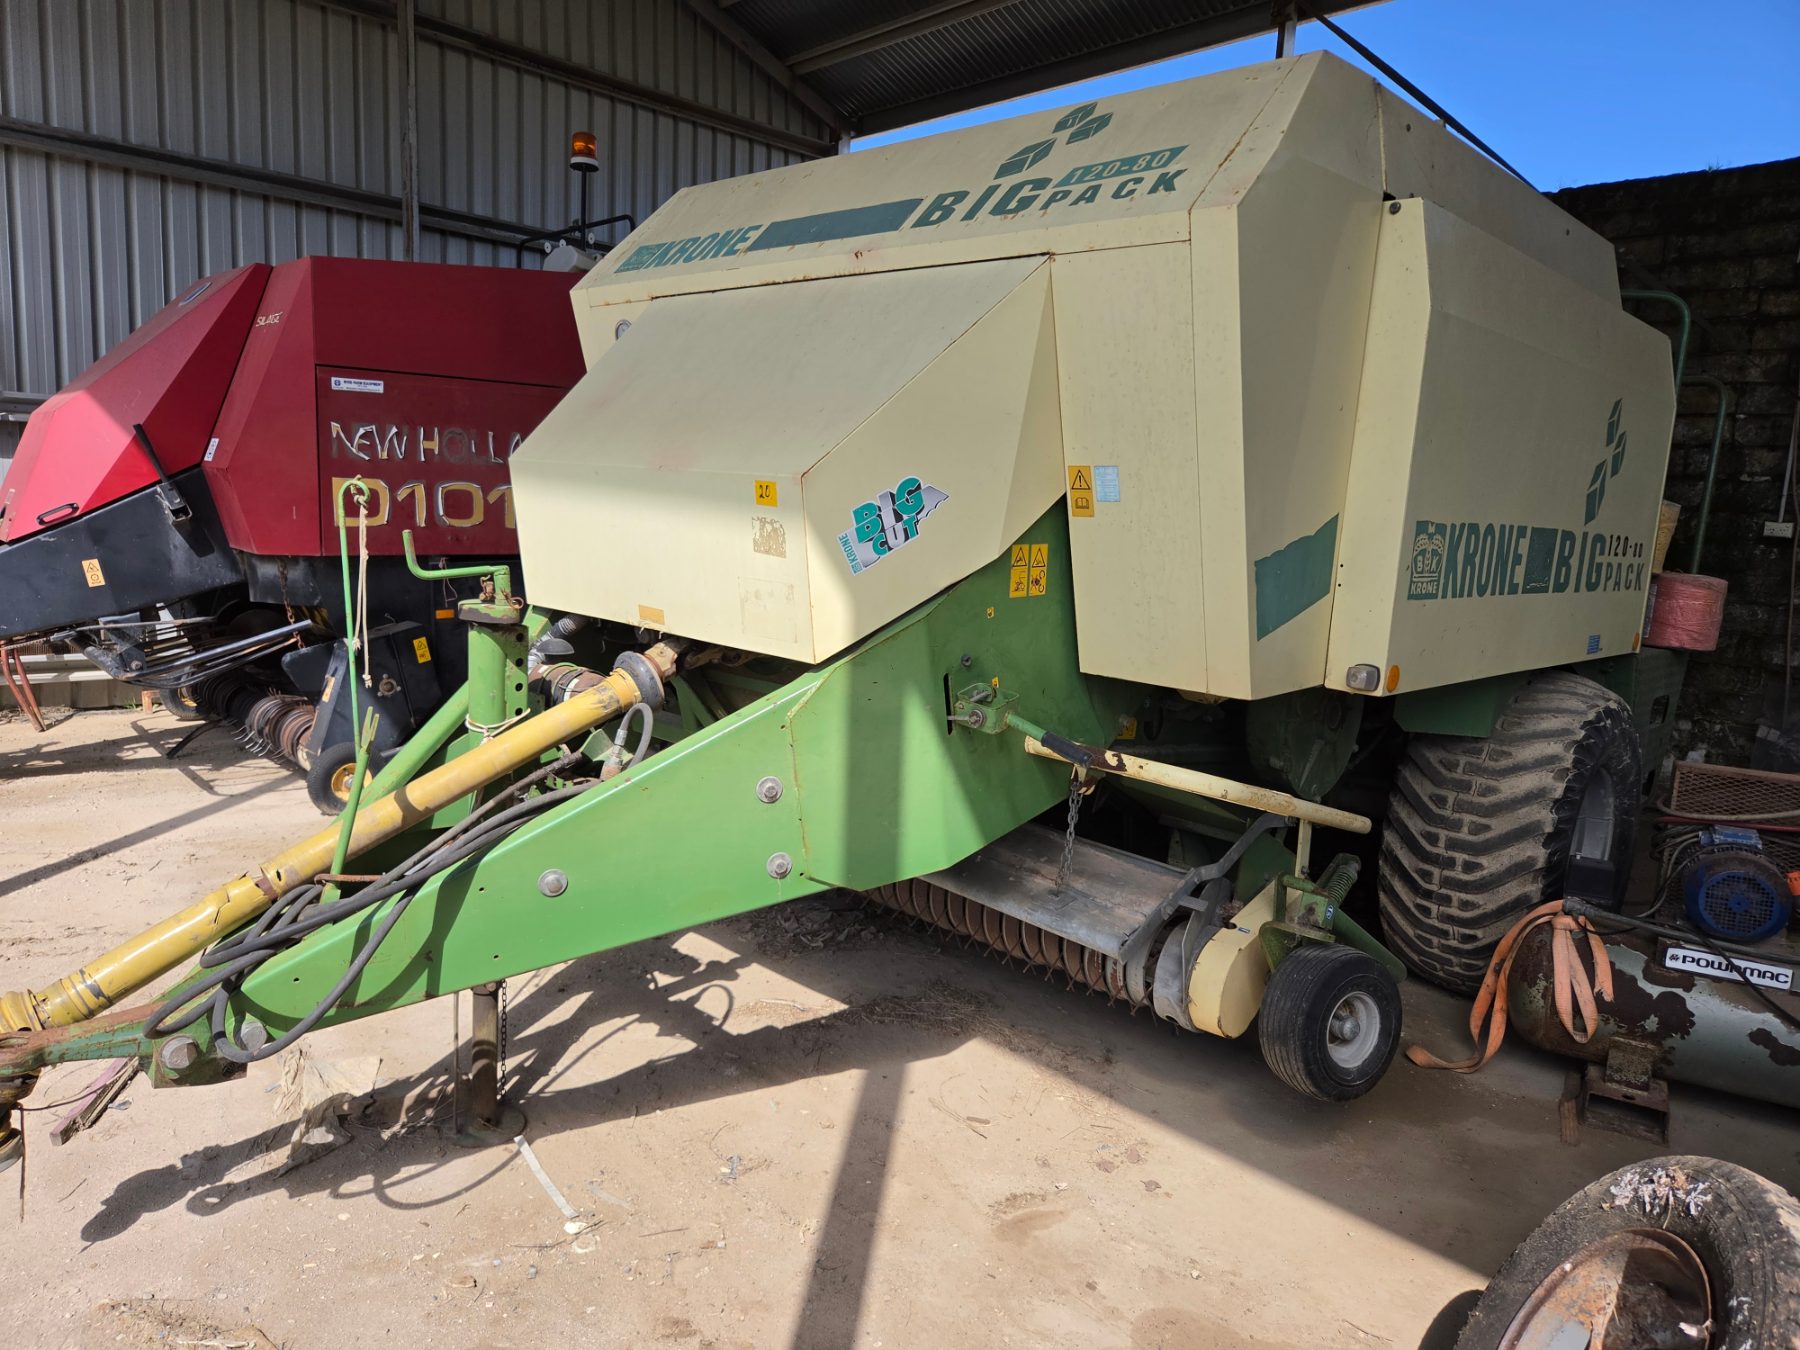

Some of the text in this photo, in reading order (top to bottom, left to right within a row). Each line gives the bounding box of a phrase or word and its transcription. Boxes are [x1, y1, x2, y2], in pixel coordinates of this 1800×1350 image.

[1069, 150, 1172, 184] 120-80
[642, 169, 1188, 270] KRONE BIG PACK
[330, 421, 409, 460] NEW
[852, 476, 925, 544] BIG
[838, 532, 859, 565] KRONE
[872, 514, 919, 556] CUT
[1441, 522, 1645, 599] KRONE BIG PACK
[1409, 582, 1439, 595] KRONE
